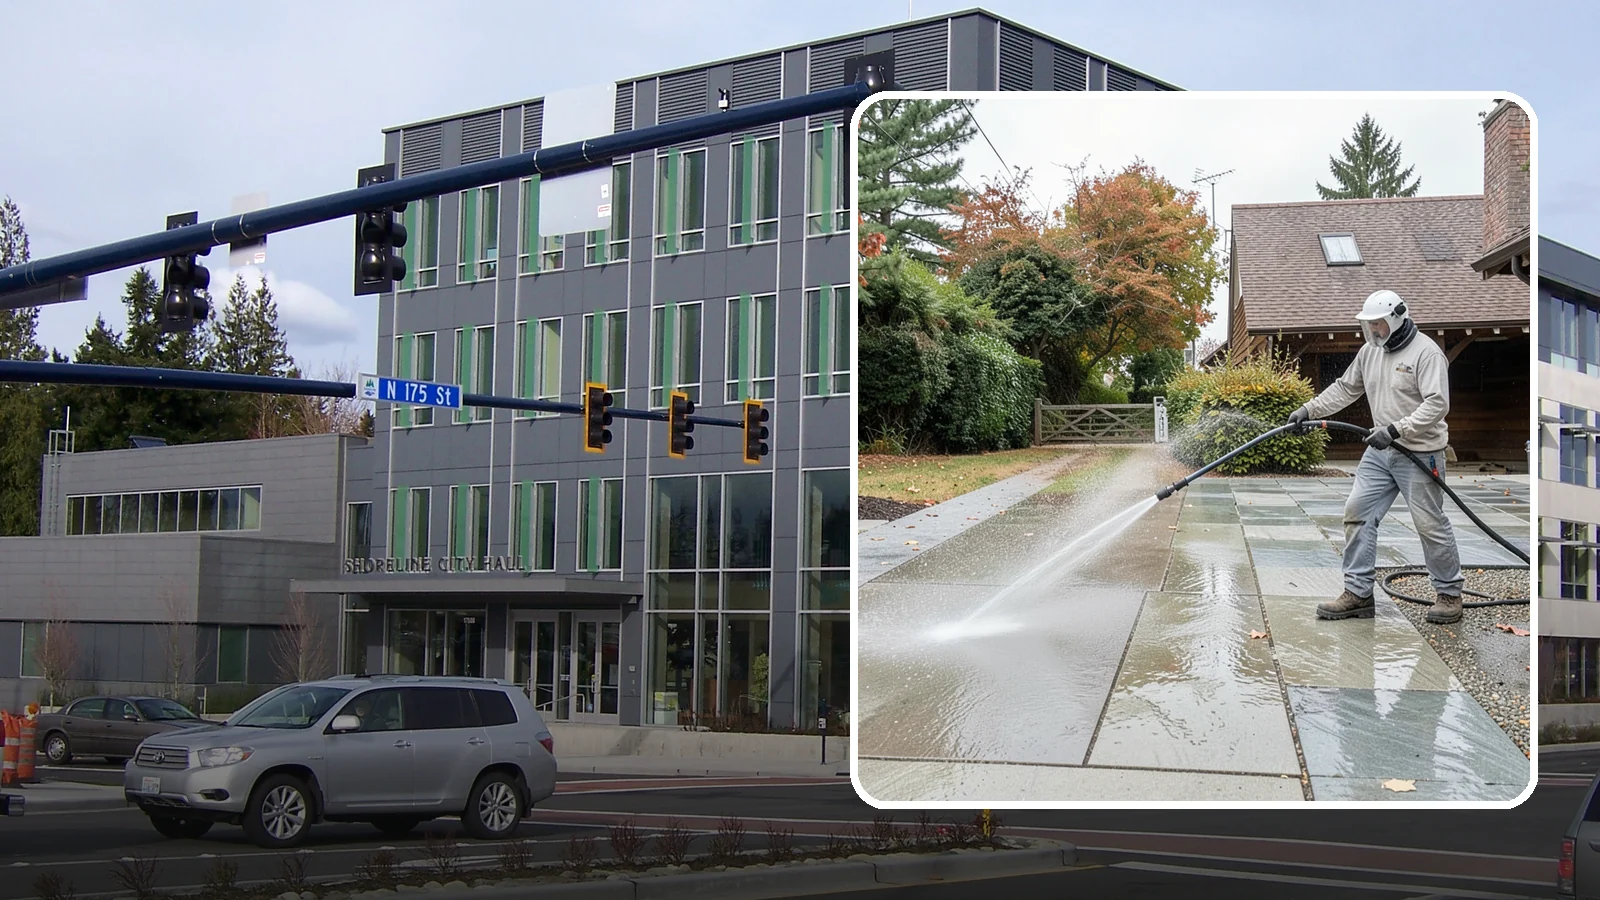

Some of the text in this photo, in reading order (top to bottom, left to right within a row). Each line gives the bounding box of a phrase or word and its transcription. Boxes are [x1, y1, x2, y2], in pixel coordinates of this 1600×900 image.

[387, 381, 451, 406] N 175 St
[343, 556, 525, 574] SHORELINE CITY HALL
